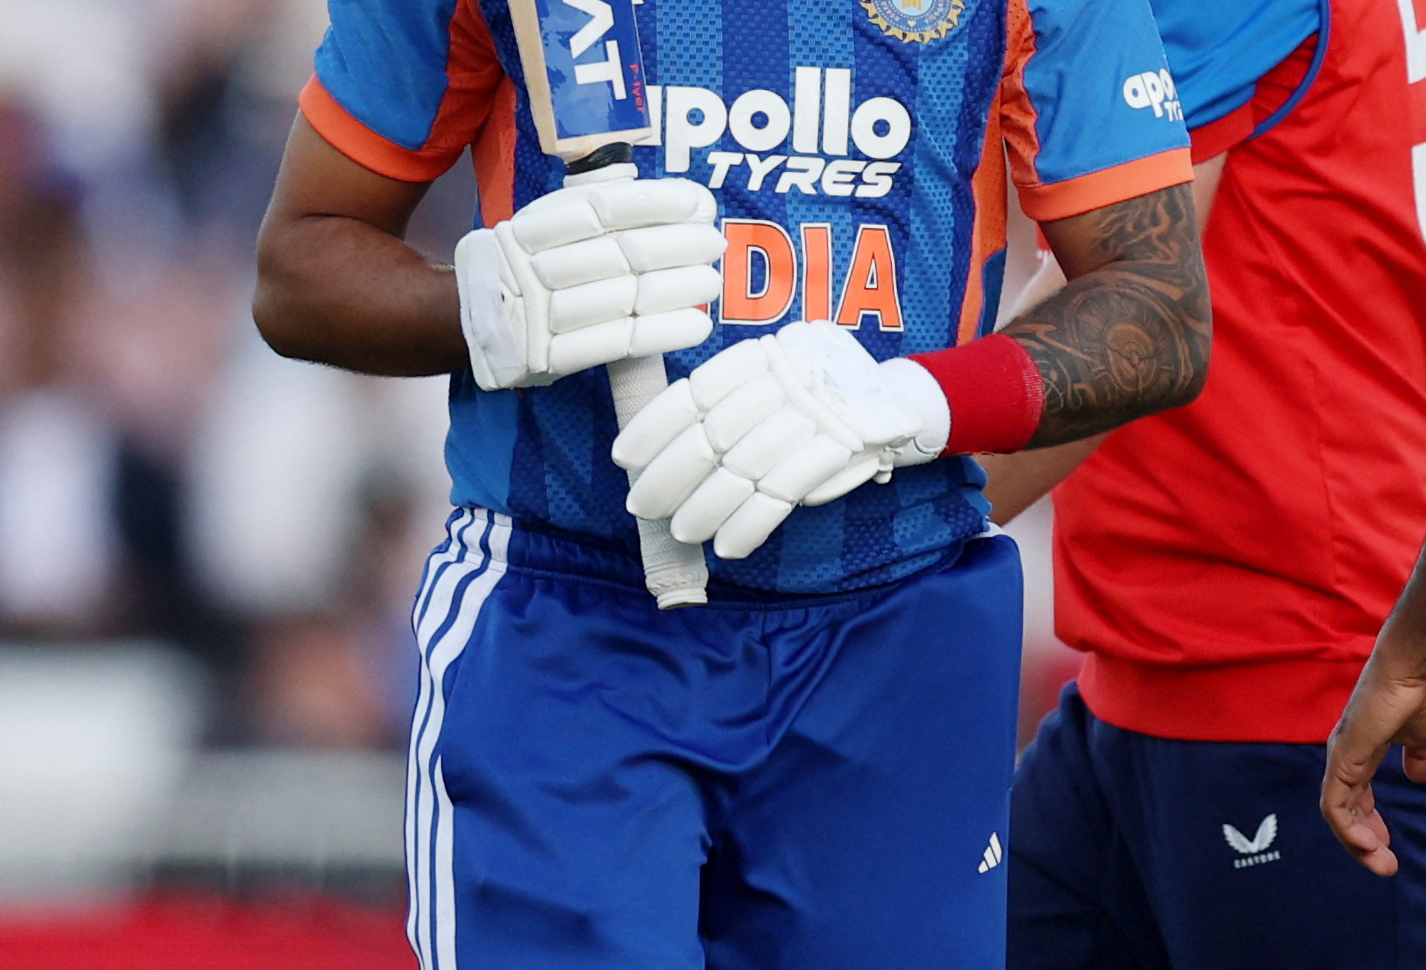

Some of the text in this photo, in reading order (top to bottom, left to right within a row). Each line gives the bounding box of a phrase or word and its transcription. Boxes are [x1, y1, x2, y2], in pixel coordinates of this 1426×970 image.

[636, 66, 911, 173] pollo
[1123, 55, 1179, 118] apo
[706, 151, 902, 198] TYRES
[694, 218, 904, 332] DIA
